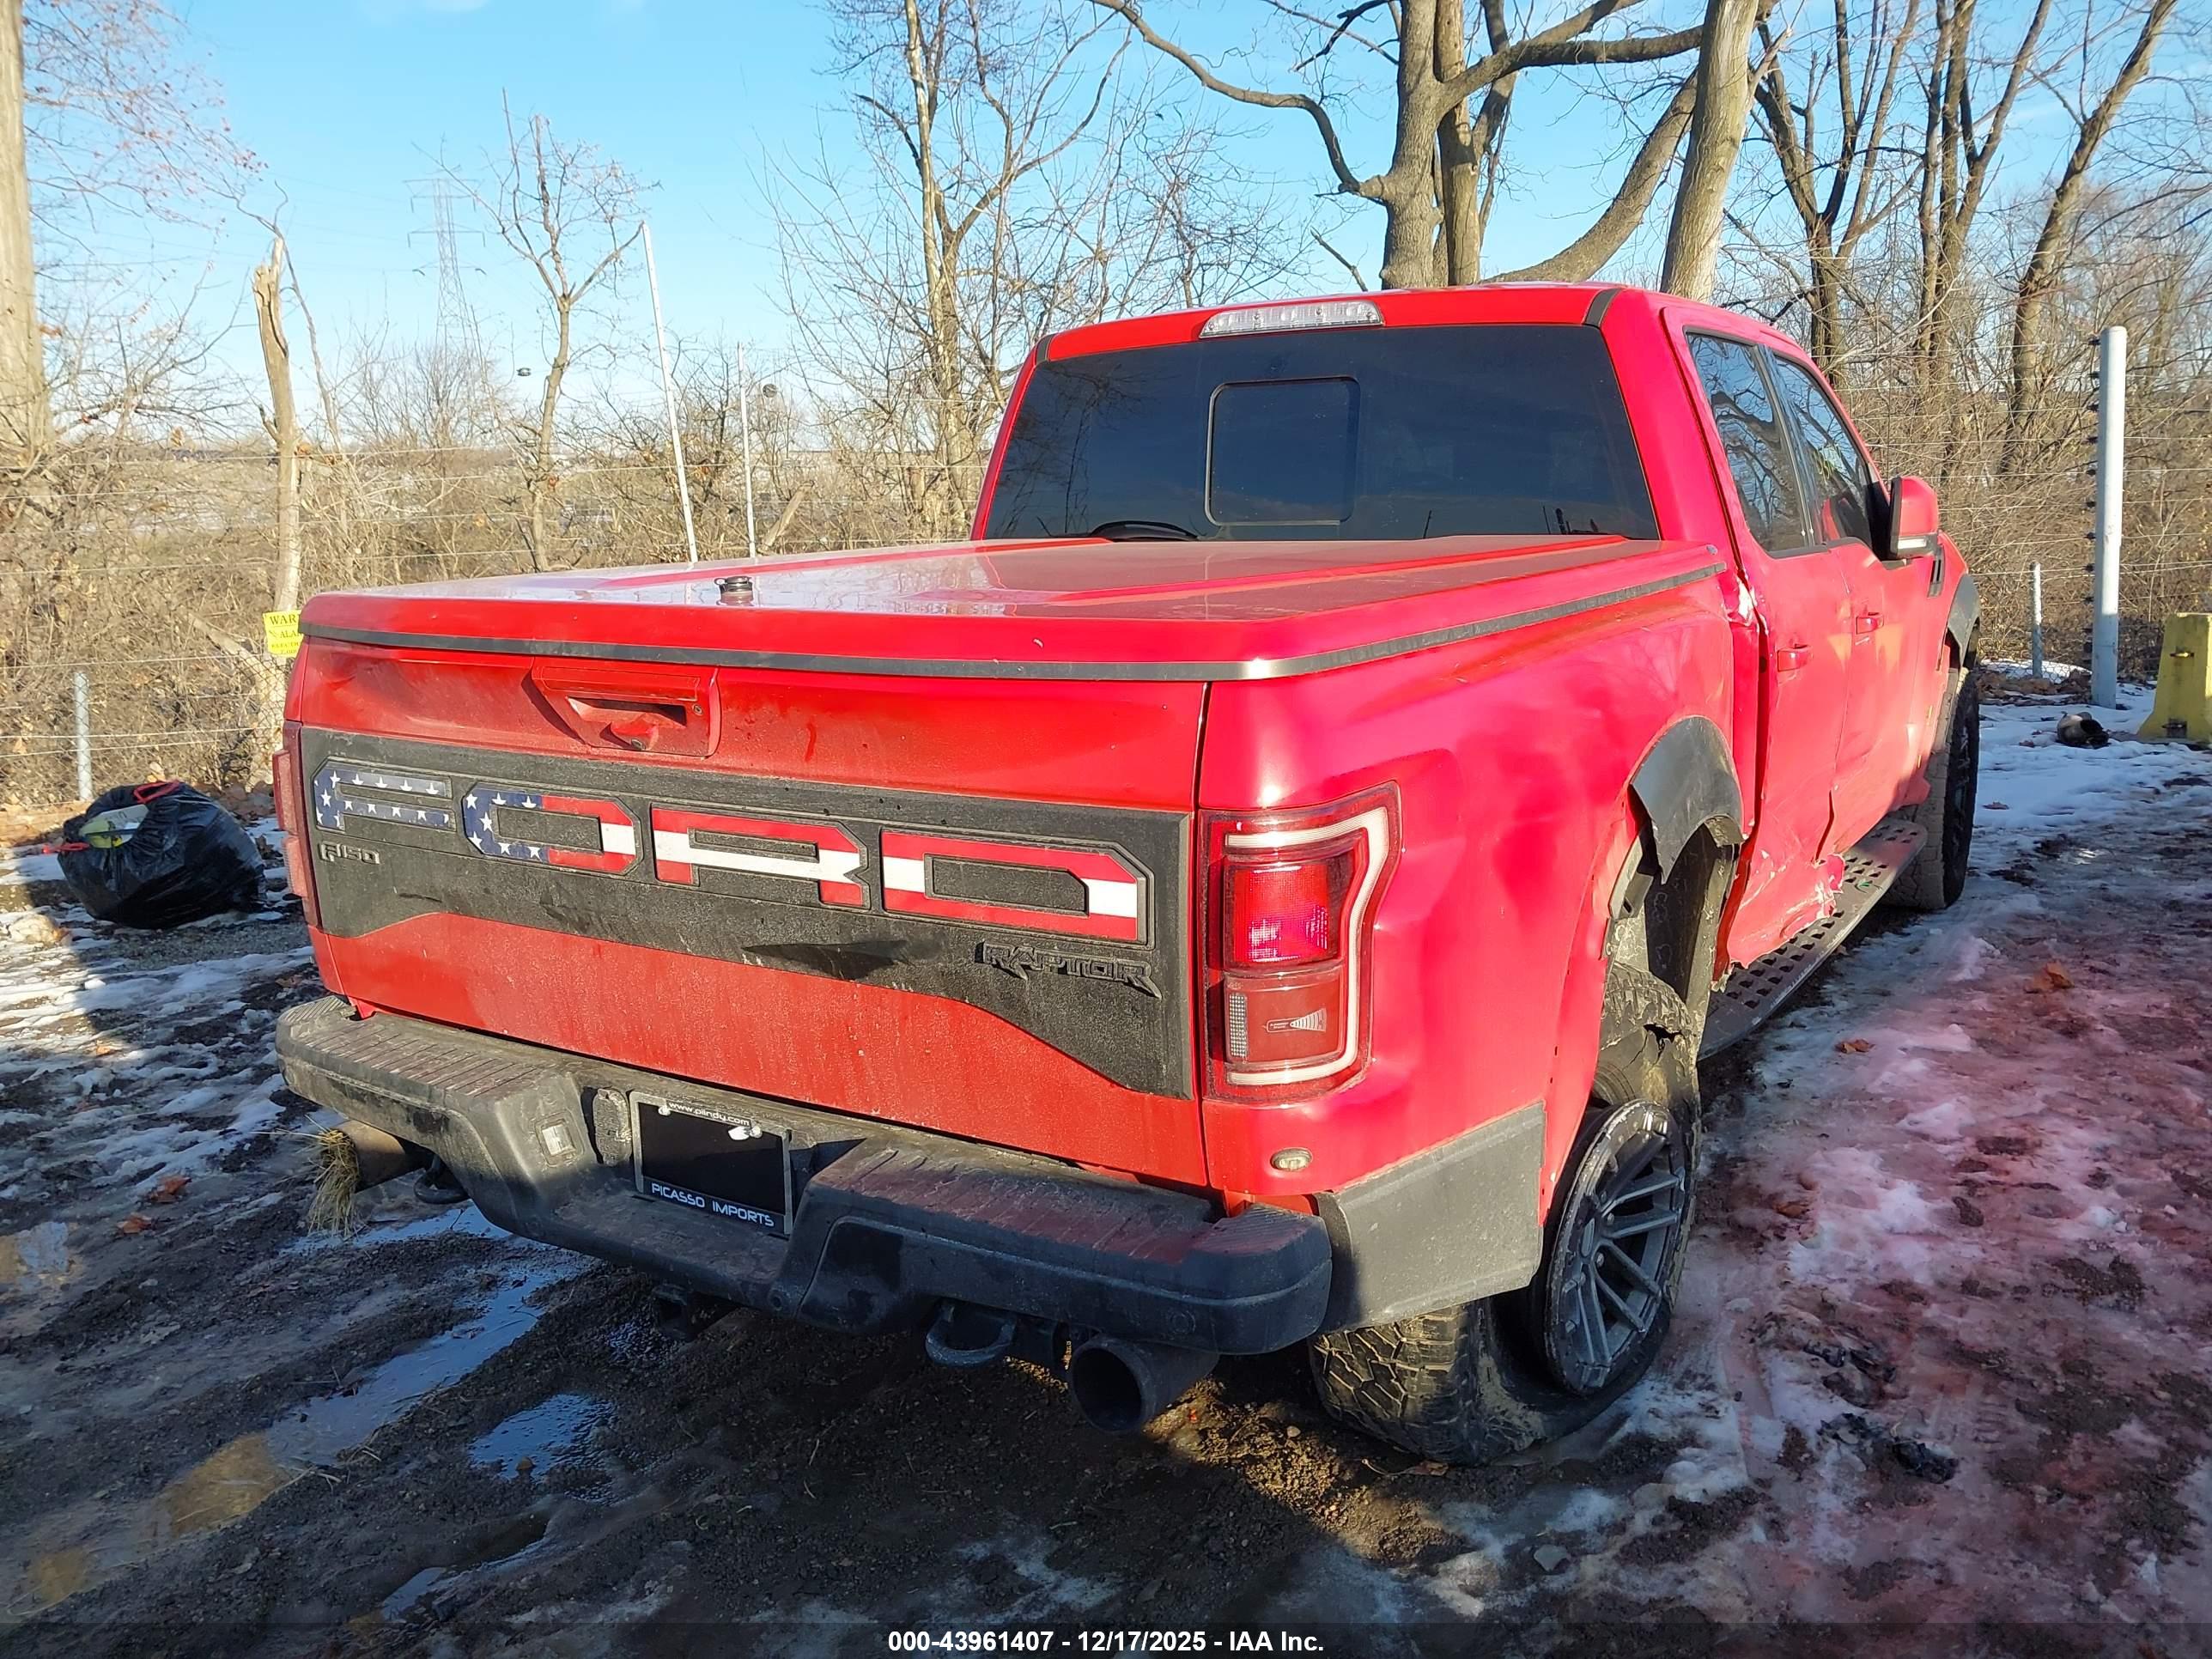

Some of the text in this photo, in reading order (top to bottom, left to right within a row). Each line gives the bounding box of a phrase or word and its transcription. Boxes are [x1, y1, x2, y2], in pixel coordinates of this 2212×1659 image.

[313, 759, 1151, 948] FORD
[975, 942, 1162, 1000] RAPTOR
[652, 1183, 775, 1227] PICASSO IMPORTS
